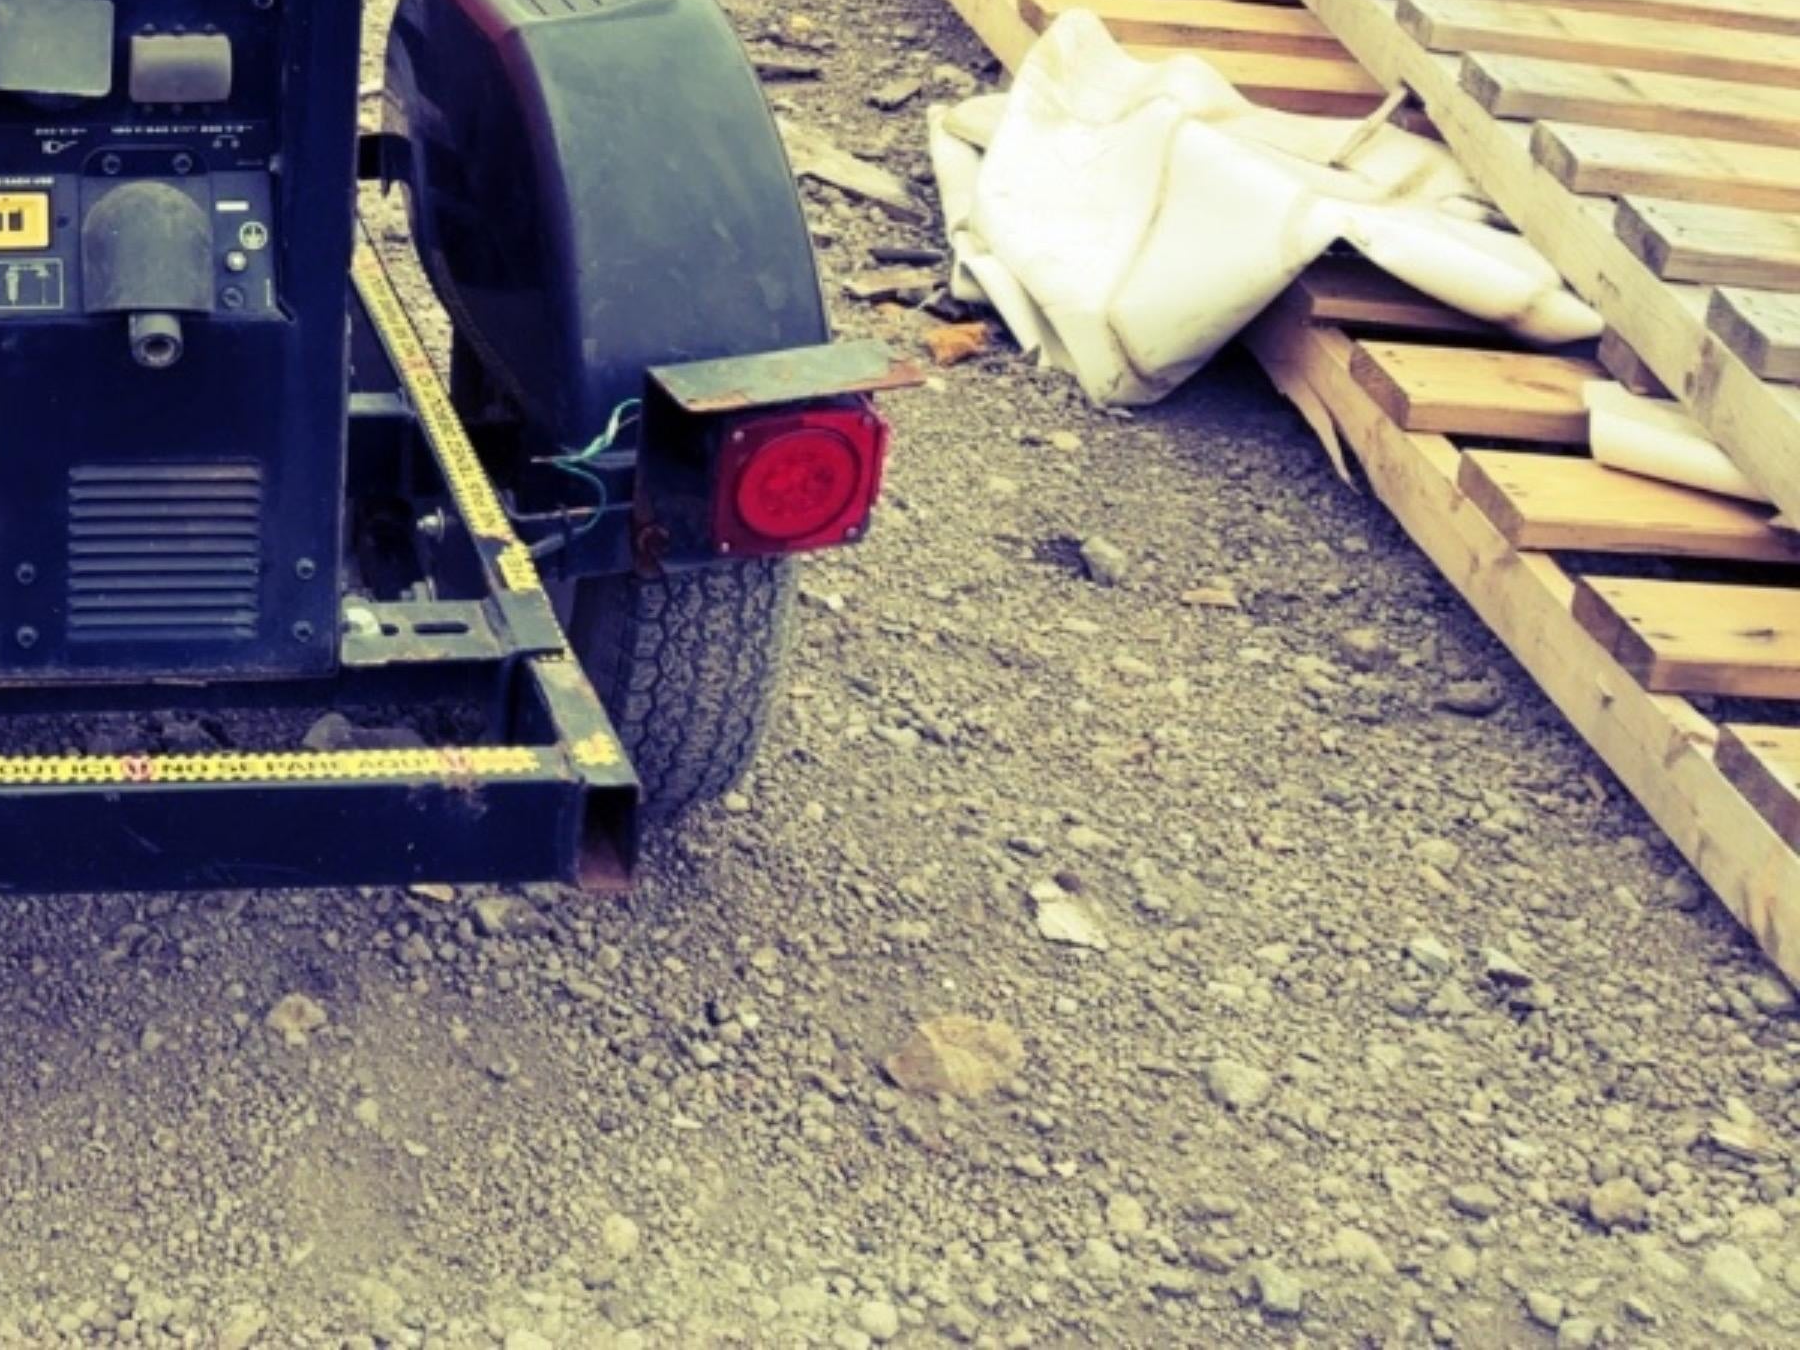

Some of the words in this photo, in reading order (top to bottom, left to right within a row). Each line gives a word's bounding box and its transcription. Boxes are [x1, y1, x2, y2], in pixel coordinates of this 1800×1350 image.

[67, 762, 114, 775] ICI
[161, 761, 211, 775] NO
[217, 760, 253, 773] SE
[264, 758, 347, 772] PARE
